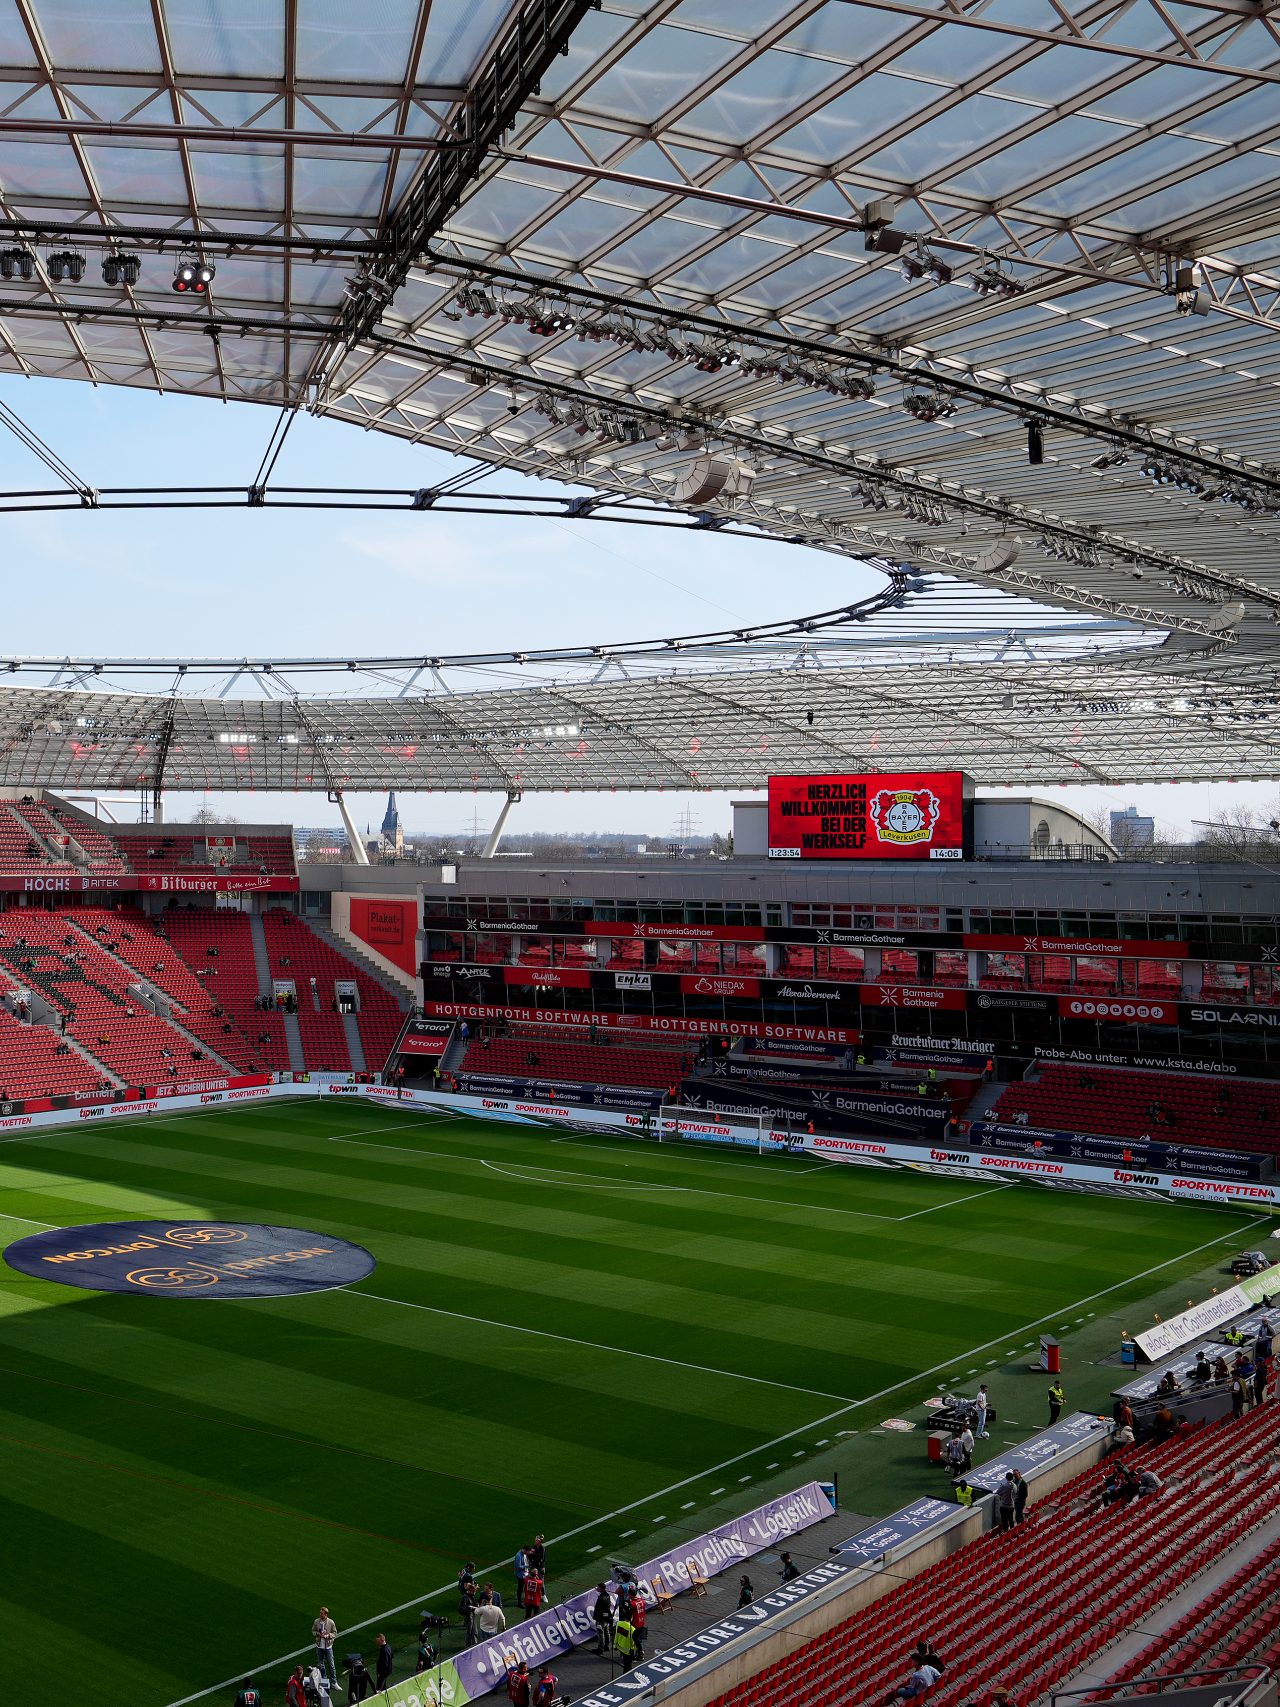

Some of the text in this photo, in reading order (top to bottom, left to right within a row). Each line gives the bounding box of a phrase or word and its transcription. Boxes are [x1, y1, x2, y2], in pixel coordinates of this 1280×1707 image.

[808, 784, 867, 799] HERZLICH
[781, 801, 867, 816] WILLKOMMEN
[821, 817, 867, 832] BEI DER
[802, 833, 867, 848] WERKSELF
[770, 849, 800, 857] 1:23:54
[934, 849, 959, 857] 14:06
[161, 876, 219, 890] Bitburger
[479, 920, 539, 931] BarmeniaGothaer
[648, 926, 714, 936] BarmeniaGothaer
[833, 933, 905, 944] BarmeniaGothaer
[1041, 940, 1123, 952] BarmeniaGothaer
[713, 980, 745, 990] NIEDAX
[777, 984, 841, 1001] Alexanderwerk
[902, 988, 945, 999] Barmenia
[902, 998, 938, 1008] Gothaer
[435, 1004, 530, 1021] HOTTGENROTH
[535, 1010, 609, 1025] SOFTWARE
[650, 1018, 759, 1037] HOTTGENROTH
[765, 1025, 847, 1043] SOFTWARE
[767, 1040, 826, 1053] BarmeniaGothaer
[899, 1051, 964, 1064] BarmeniaGothaer
[1034, 1047, 1238, 1073] Probe-Abo unter: www.ksta.de/abo
[470, 1074, 515, 1083] BarmeniaGothaer
[176, 1082, 206, 1095] SICHERN
[206, 1079, 229, 1091] UNTER:
[329, 1084, 358, 1095] tipwin
[469, 1084, 514, 1095] BarmeniaGothaer
[200, 1087, 270, 1104] tipwin SPORTWETTEN
[535, 1090, 581, 1101] BarmiaGothaer
[603, 1096, 652, 1108] BarmeniaGothaer
[79, 1101, 158, 1119] tipwin SPORTWETTEN
[481, 1098, 509, 1110] tipwin
[514, 1104, 569, 1117] SPORTWETTEN
[706, 1100, 808, 1121] BarmeniaGothaer
[836, 1097, 948, 1119] BarmeniaGothaer
[664, 1121, 730, 1136] SPORTWETTEN
[769, 1131, 804, 1145] tipwin
[813, 1137, 886, 1154] SPORTWETTEN
[1086, 1137, 1150, 1149] BarmeniaGothaer
[929, 1147, 970, 1164] tipwin
[980, 1157, 1064, 1174] SPORTWETTEN
[1084, 1149, 1148, 1164] BarmeniaGhaer
[1181, 1148, 1251, 1161] BarmeniaGothaer
[1180, 1161, 1249, 1176] BarmeniaGothaer
[1113, 1169, 1160, 1186] tipwin
[1171, 1178, 1268, 1198] SPORTWETTEN
[227, 1246, 334, 1271] DITCON
[1170, 1323, 1184, 1340] Ihr
[1182, 1290, 1246, 1333] Containerdienst
[659, 1493, 819, 1587] Recycling Logistik
[764, 1562, 847, 1608] CASTORE
[651, 1621, 745, 1673] CASTORE
